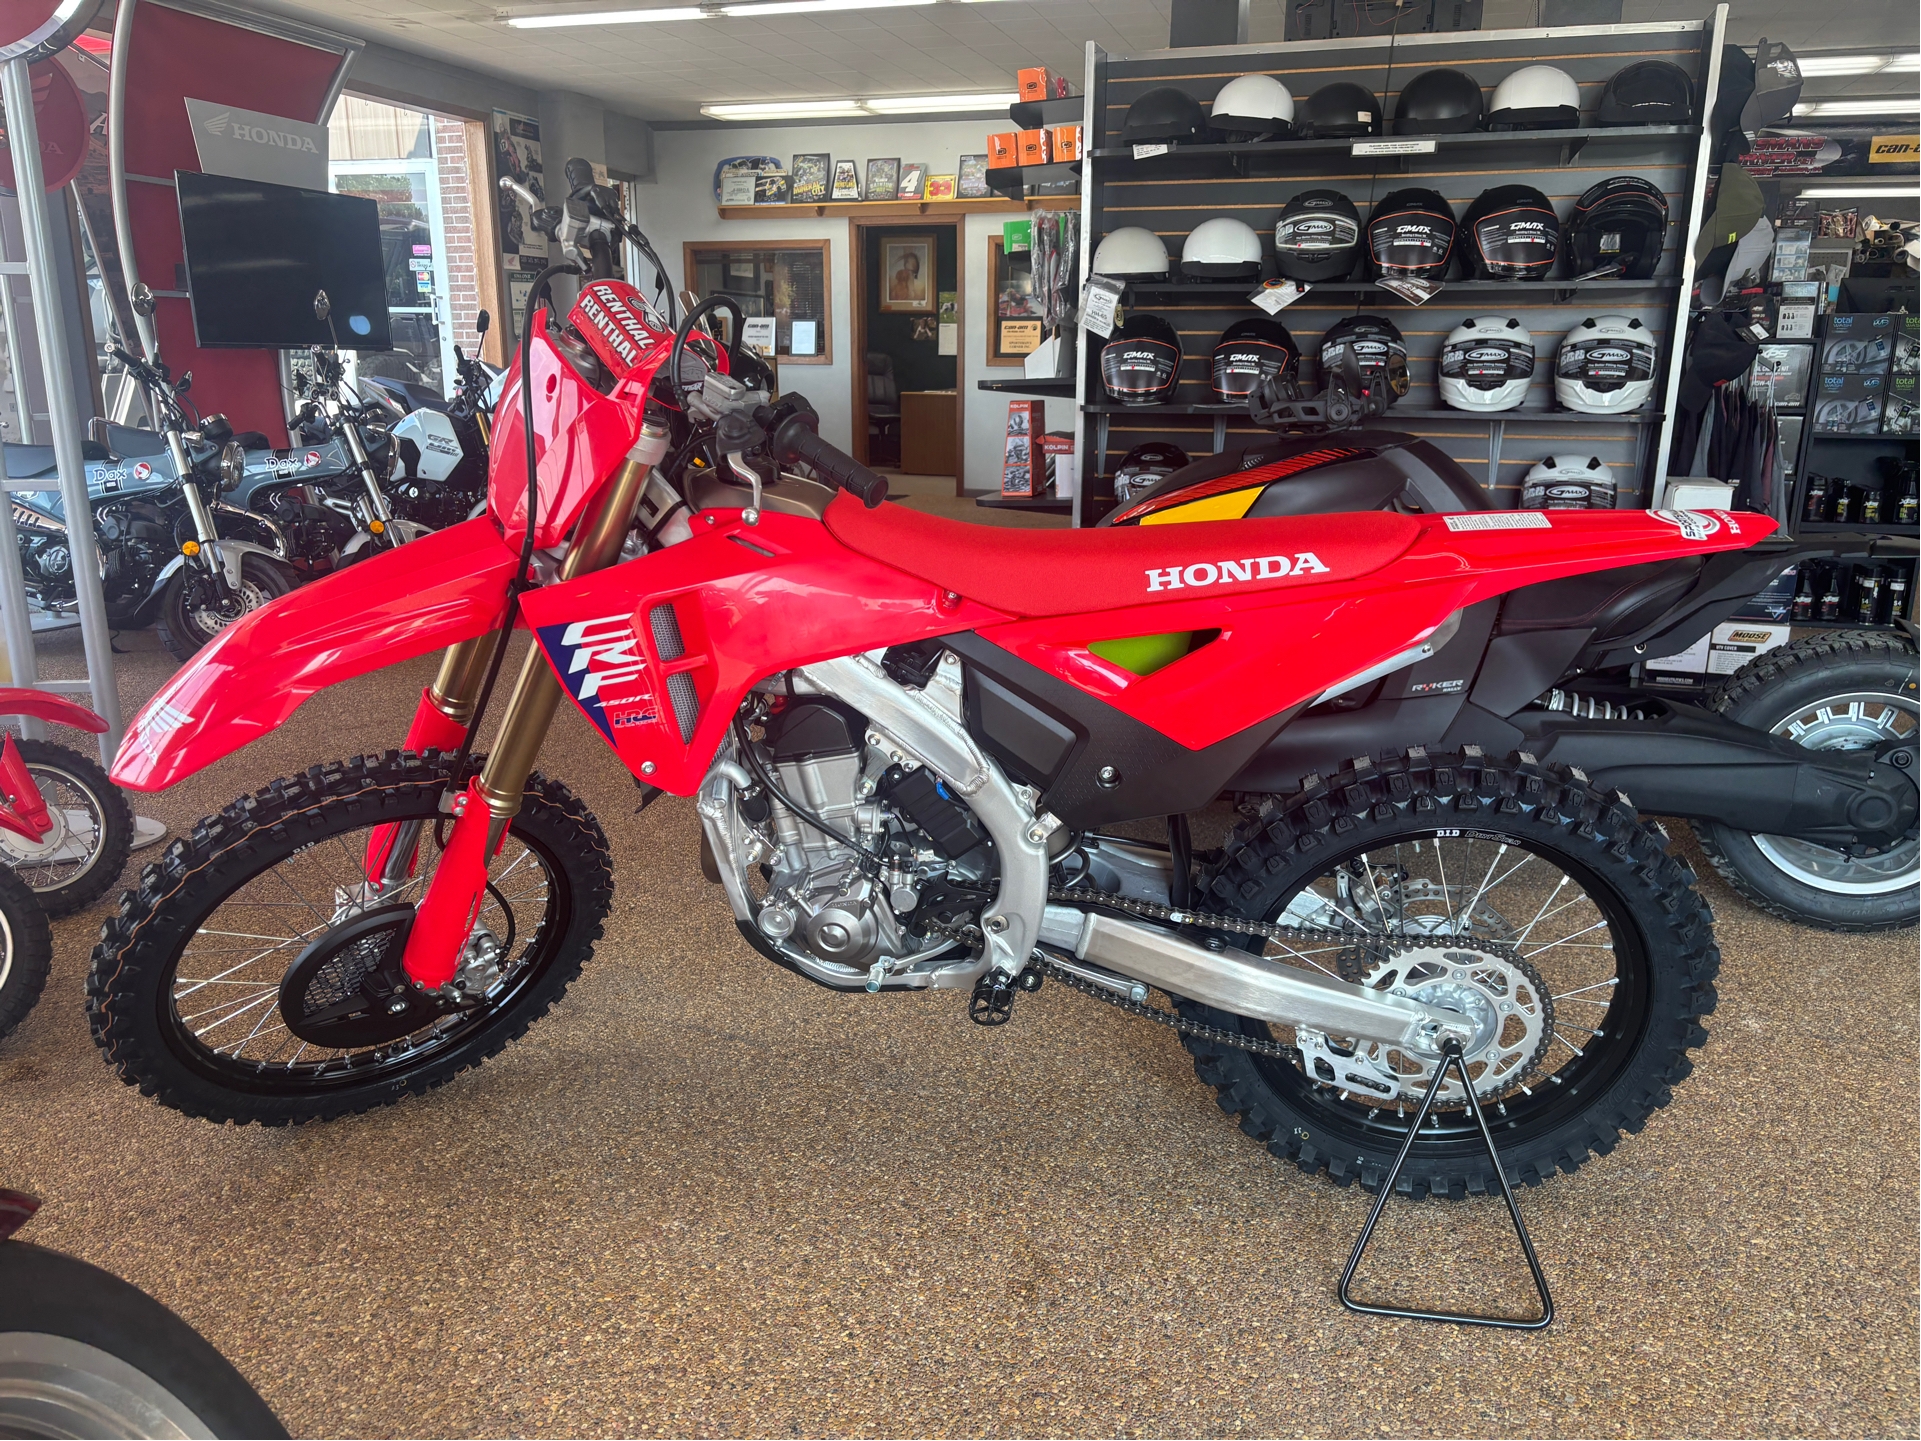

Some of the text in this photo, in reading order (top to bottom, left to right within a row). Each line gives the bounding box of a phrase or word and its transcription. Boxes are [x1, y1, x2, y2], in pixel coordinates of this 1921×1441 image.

[231, 122, 319, 154] HONDA
[901, 170, 921, 192] 4
[1297, 222, 1333, 232] GMAX
[1396, 225, 1432, 234] GMAX
[1510, 221, 1545, 231] GMAX
[592, 285, 655, 350] RENTHAL
[1834, 316, 1853, 324] total
[580, 294, 637, 367] RENTHAL
[1123, 351, 1155, 360] GMAX
[1230, 354, 1260, 362] GMAX
[1466, 349, 1507, 359] GMAX
[1587, 349, 1630, 360] GMAX
[1825, 376, 1844, 384] total
[1896, 377, 1915, 385] total
[266, 457, 300, 470] Dax
[93, 467, 127, 483] Dax
[1547, 486, 1588, 497] GMAX
[1145, 552, 1330, 592] HONDA
[1733, 631, 1768, 640] MOOSE
[561, 612, 648, 700] CRF
[1412, 680, 1464, 692] RYKER
[592, 693, 654, 708] 450R
[613, 707, 658, 726] HRC
